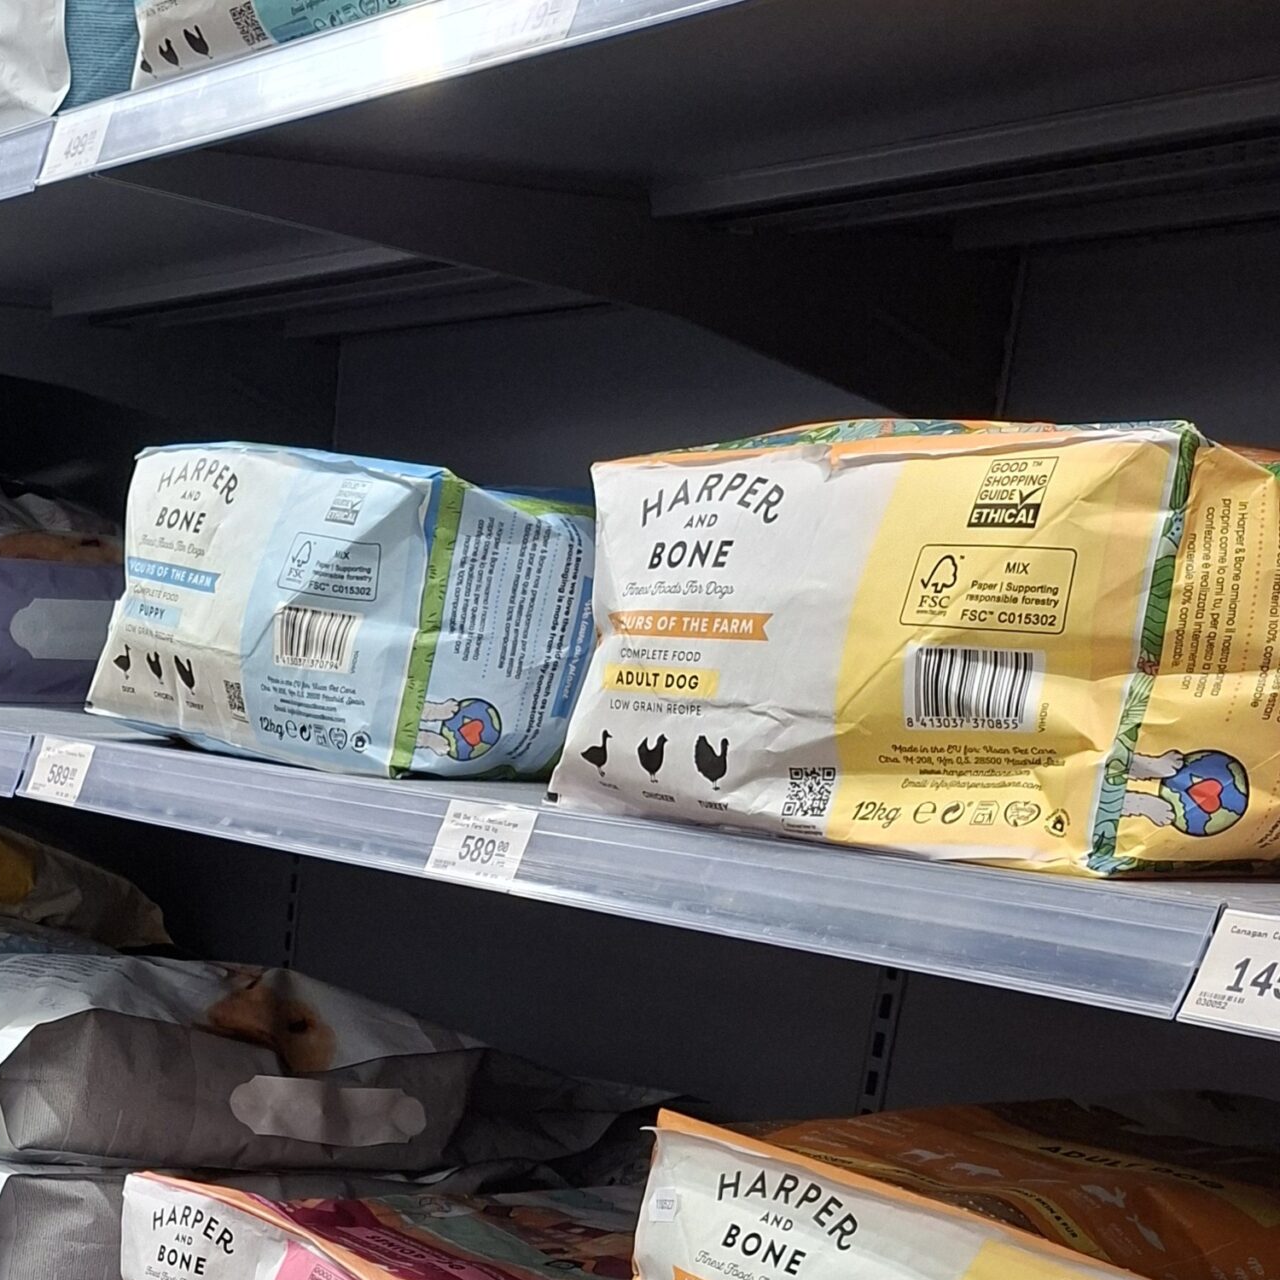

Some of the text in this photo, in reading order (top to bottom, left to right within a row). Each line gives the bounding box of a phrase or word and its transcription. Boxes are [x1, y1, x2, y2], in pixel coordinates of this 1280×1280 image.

[990, 462, 1028, 474] GOOD
[157, 458, 238, 504] HARPER
[983, 474, 1048, 487] SHOPPING
[180, 490, 201, 501] AND
[641, 472, 785, 528] HARPER
[979, 489, 1016, 501] GUIDE
[155, 506, 206, 533] BONE
[684, 513, 718, 529] AND
[970, 509, 1036, 524] ETHICAL
[1233, 512, 1248, 546] Harper
[648, 540, 734, 569] BONE
[1005, 562, 1030, 575] MIX
[1232, 556, 1245, 581] Bone
[706, 581, 734, 599] Dogs
[1005, 582, 1059, 595] Supporting
[918, 594, 950, 609] FSC
[966, 594, 1059, 608] responsible forestry
[139, 604, 166, 620] PUPPY
[997, 611, 1057, 626] C015302
[657, 617, 753, 634] OF THE FARM
[620, 647, 701, 663] COMPLETE FOOD
[616, 670, 700, 690] ADULT DOG
[609, 699, 702, 716] LOW GRAIN RECIPE
[920, 717, 1019, 730] 413037 370855
[48, 764, 70, 786] 589
[851, 801, 902, 828] 12kg
[458, 835, 496, 864] 589
[1231, 925, 1268, 938] Canagan
[717, 1169, 859, 1251] HARPER
[759, 1210, 793, 1232] AND
[152, 1205, 234, 1255] HARPER
[174, 1232, 193, 1246] AND
[721, 1223, 807, 1276] BONE
[157, 1245, 207, 1275] BONE
